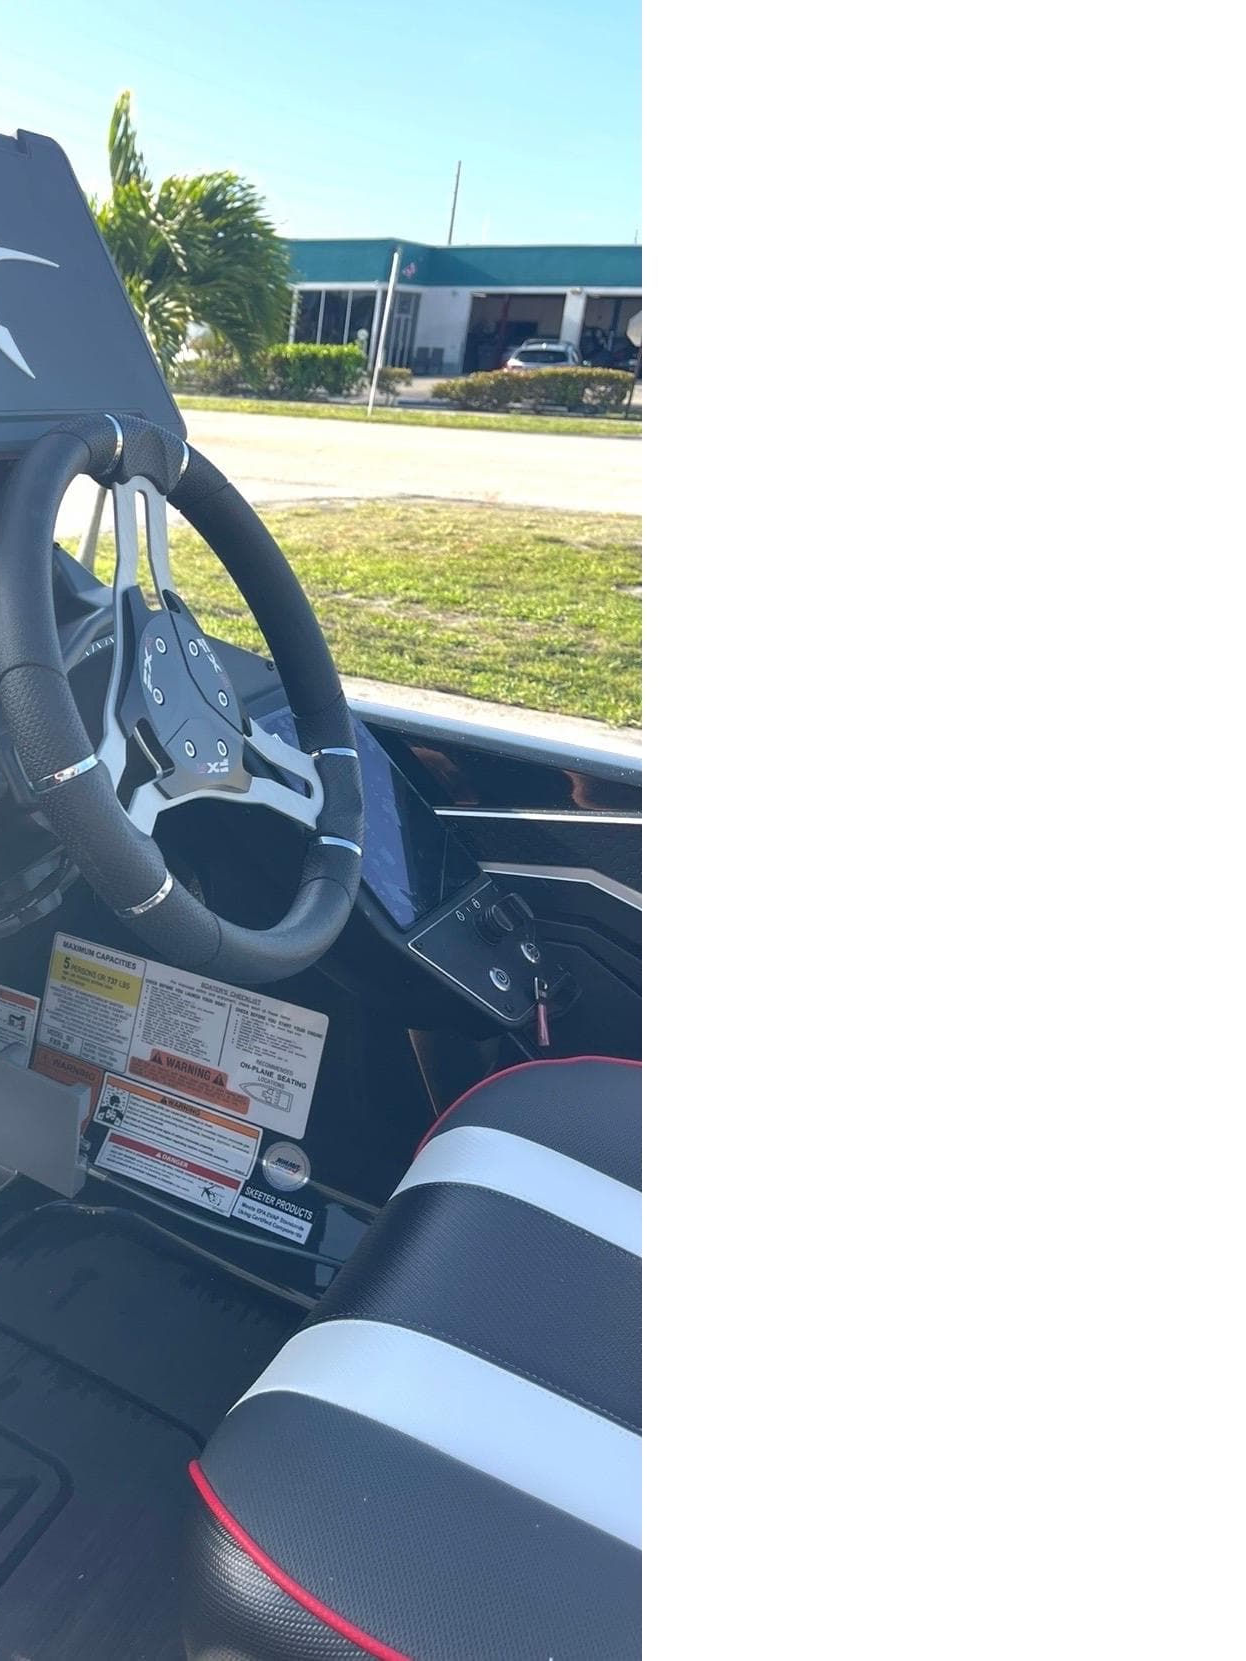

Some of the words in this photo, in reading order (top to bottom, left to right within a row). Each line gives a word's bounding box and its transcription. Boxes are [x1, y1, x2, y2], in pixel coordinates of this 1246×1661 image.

[62, 940, 95, 956] MAXIMUM
[96, 951, 137, 970] CAPACITIES
[64, 957, 71, 969] 5
[71, 965, 97, 979] PERSONS
[165, 1055, 212, 1081] WARNING
[240, 1061, 274, 1078] ON-PLANE
[277, 1073, 307, 1089] SEATING
[166, 1099, 201, 1116] WARNING
[161, 1153, 189, 1169] DANGER
[244, 1186, 276, 1206] SKEETER
[275, 1198, 314, 1221] PRODUCTS
